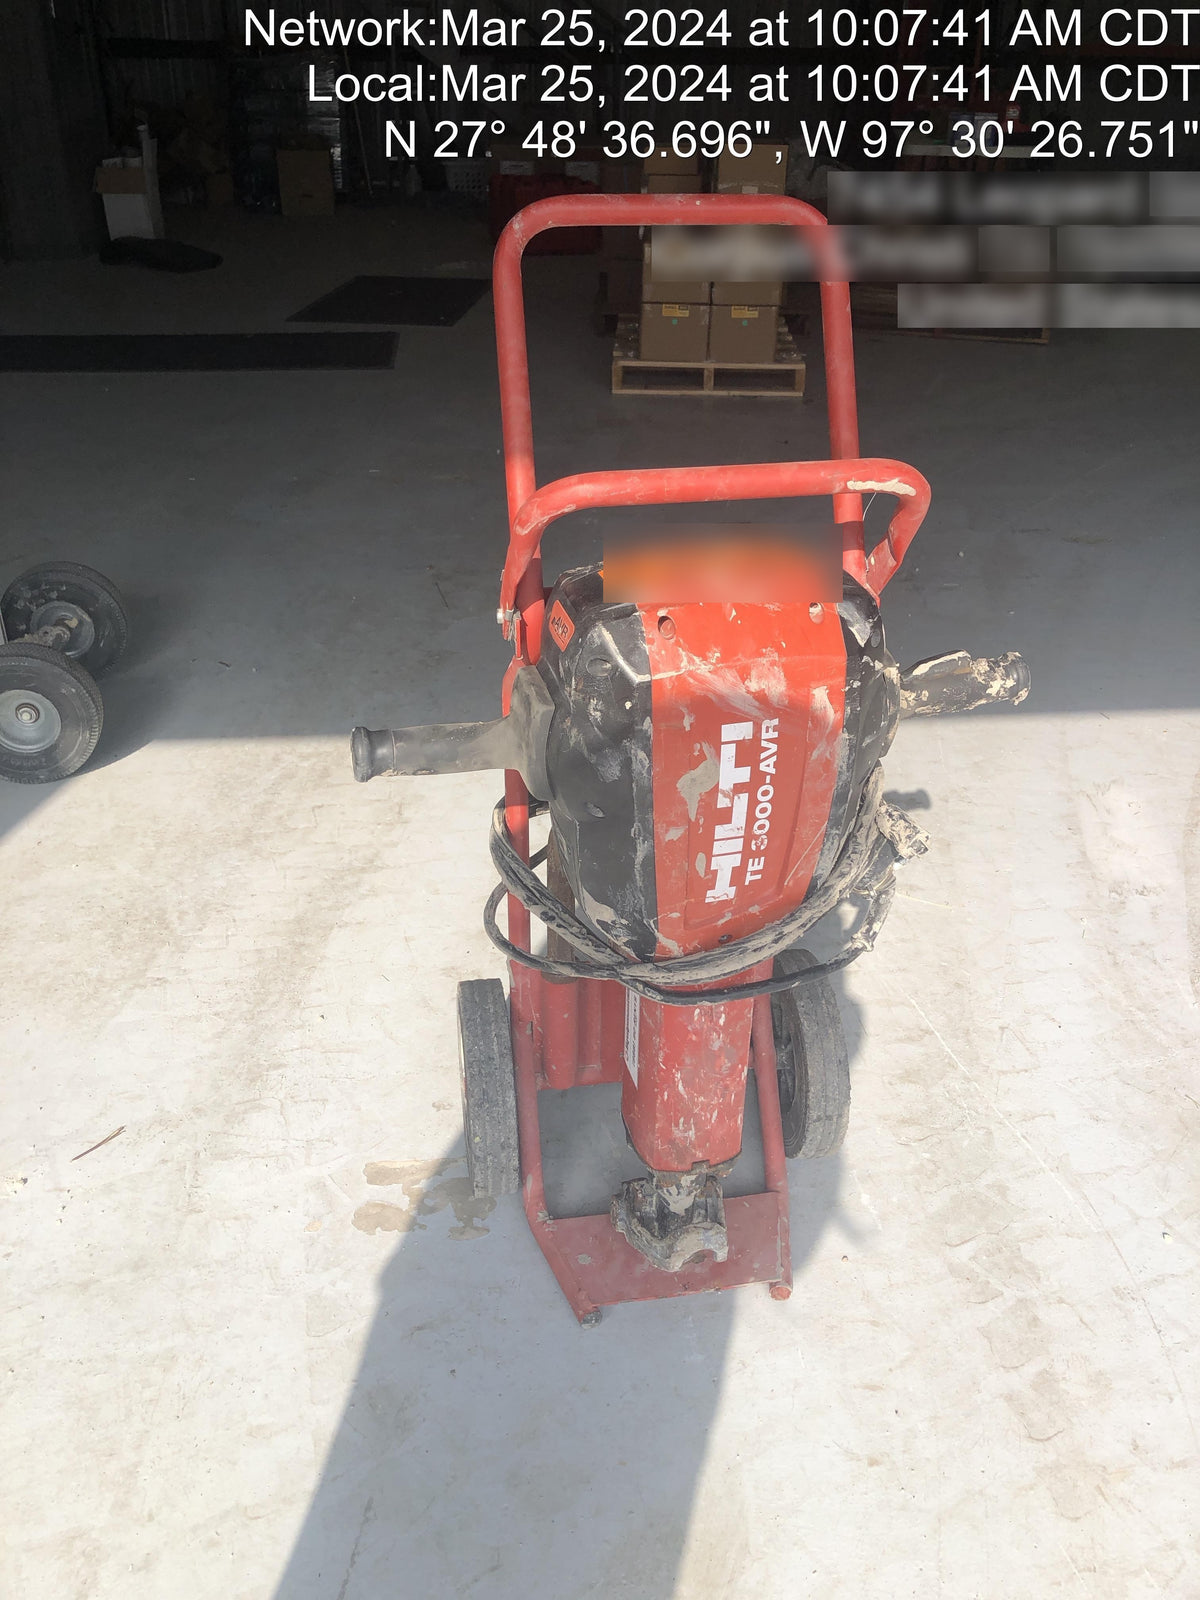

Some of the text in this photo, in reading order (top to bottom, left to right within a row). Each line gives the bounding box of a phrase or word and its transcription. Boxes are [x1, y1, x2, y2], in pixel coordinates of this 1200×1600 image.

[705, 721, 753, 903] HILTI
[745, 718, 779, 886] TE 3000-AVR
